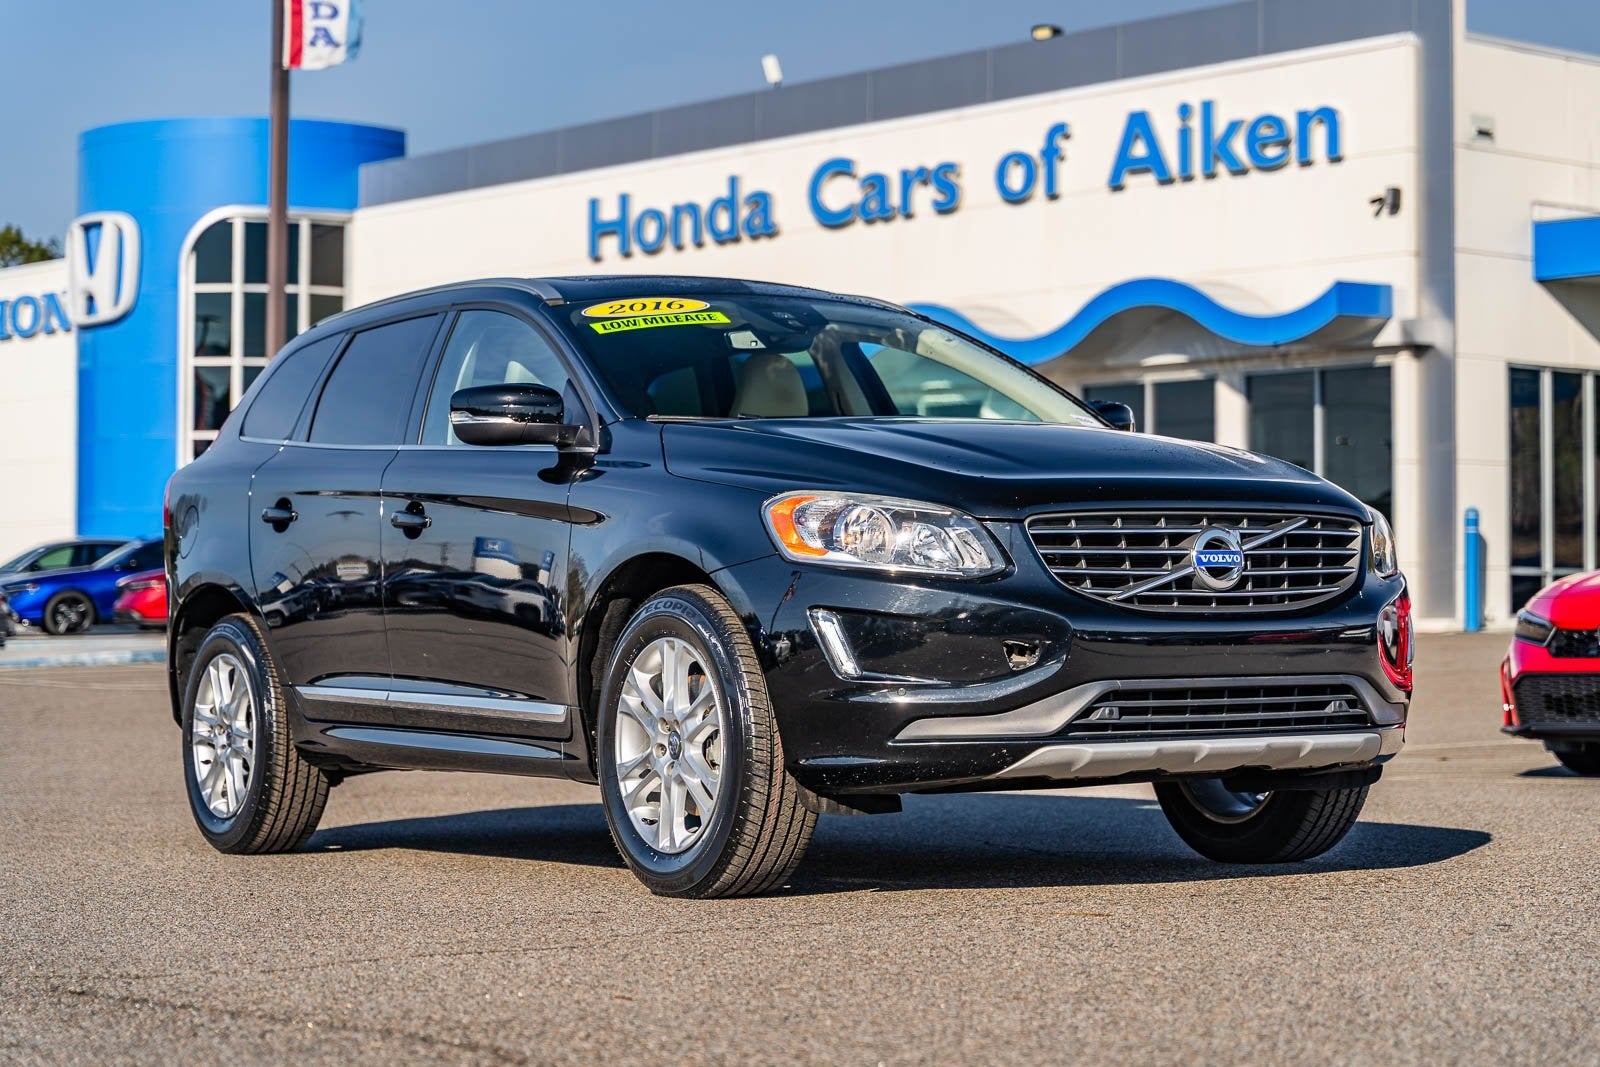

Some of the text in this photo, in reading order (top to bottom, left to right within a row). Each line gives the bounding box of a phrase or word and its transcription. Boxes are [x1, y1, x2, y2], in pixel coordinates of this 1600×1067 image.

[588, 100, 1343, 261] Honda Cars of Aiken
[608, 300, 685, 315] 2016
[601, 313, 718, 331] LOW MILEAGE
[1198, 554, 1241, 563] VOLVO
